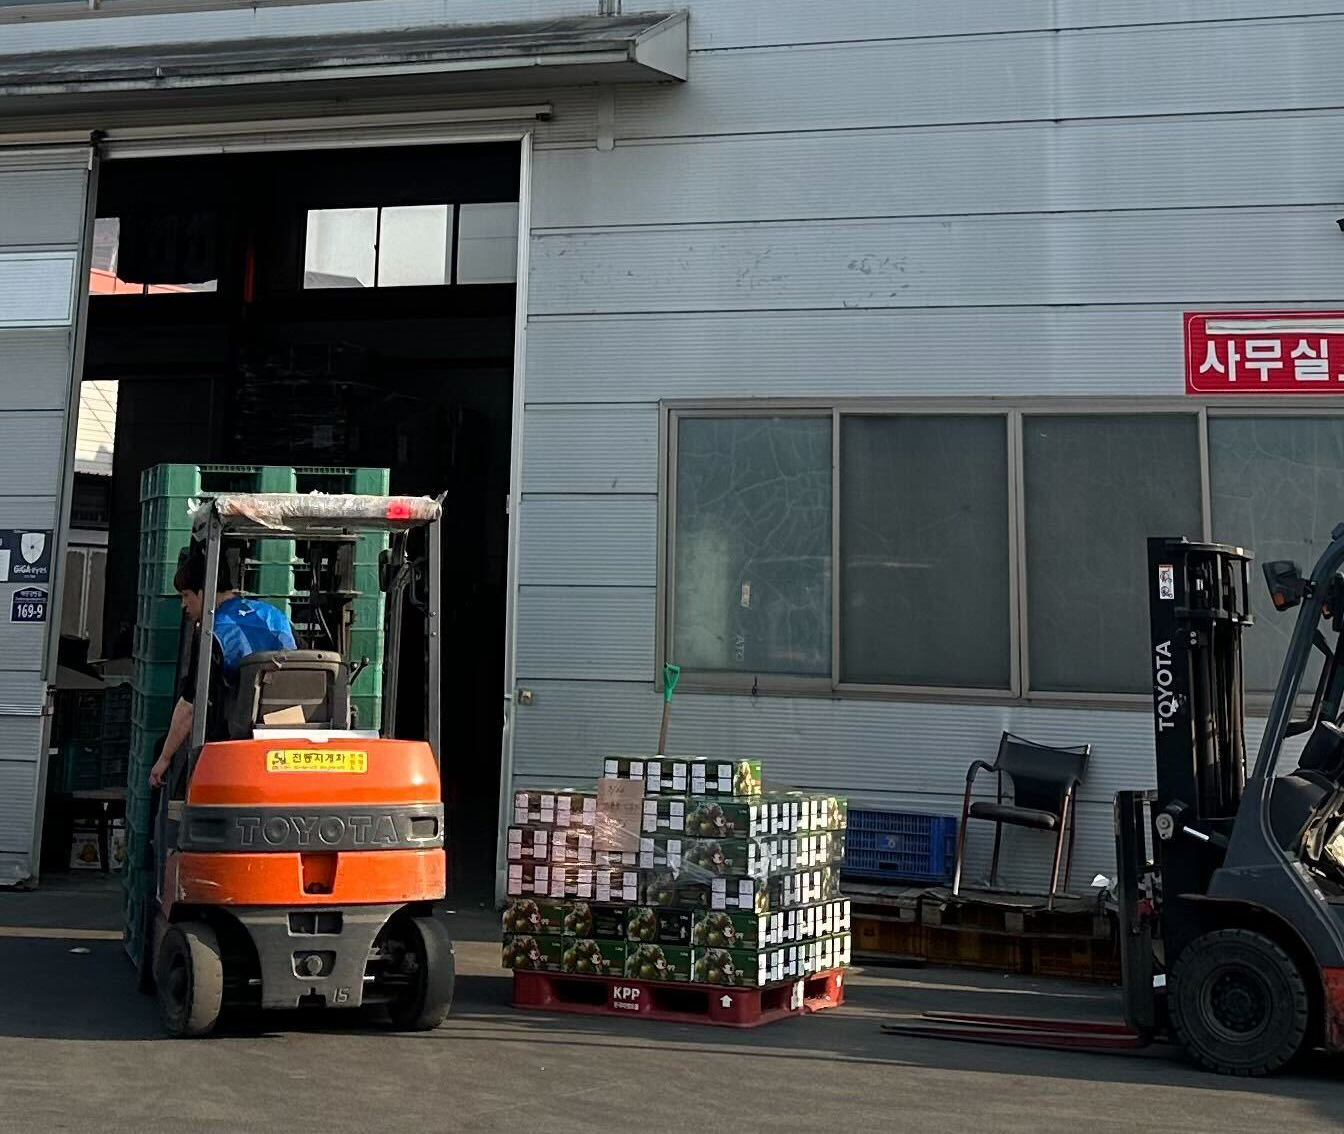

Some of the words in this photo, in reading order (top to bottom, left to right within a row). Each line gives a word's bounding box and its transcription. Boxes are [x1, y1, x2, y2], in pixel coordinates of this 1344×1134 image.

[1199, 338, 1329, 382] 사무실
[17, 604, 43, 619] 169-9
[1156, 640, 1175, 732] TOYOTA
[235, 816, 401, 846] TOYOTA
[613, 986, 641, 1000] KPP
